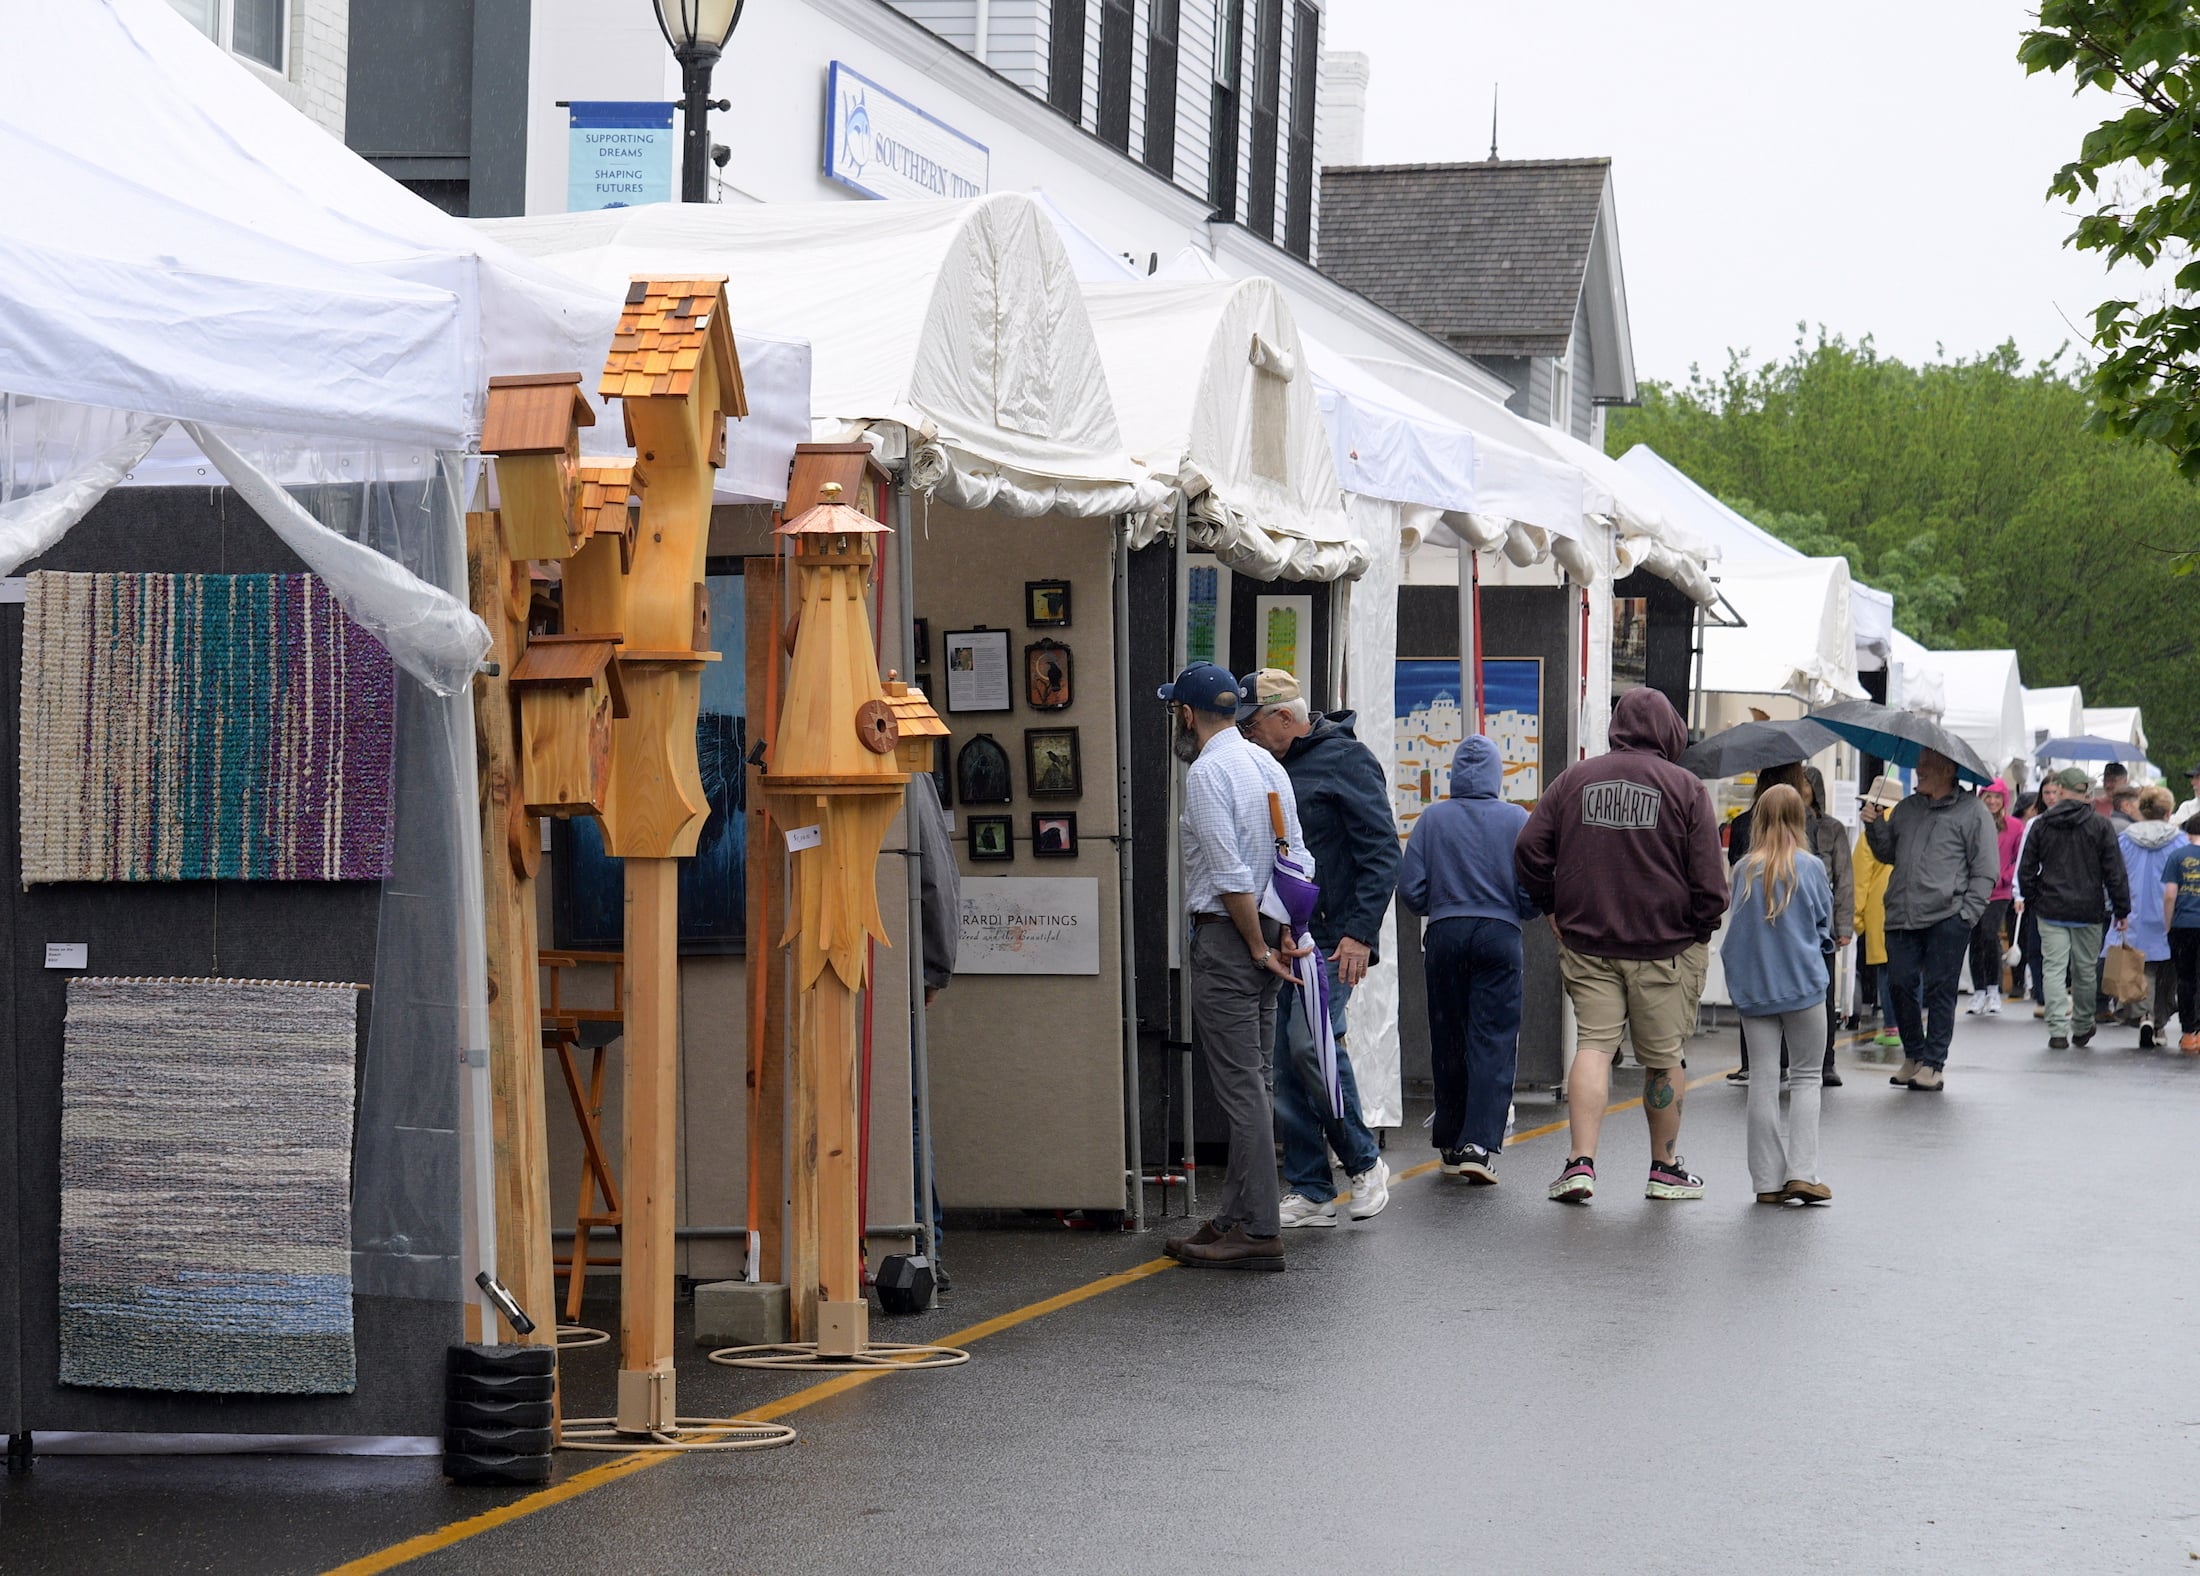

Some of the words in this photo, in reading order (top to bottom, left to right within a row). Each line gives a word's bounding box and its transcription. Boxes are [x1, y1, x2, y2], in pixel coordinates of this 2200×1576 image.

[585, 134, 654, 144] SUPPORTING
[599, 148, 643, 157] DREAMS
[875, 131, 948, 197] SOUTHERN
[594, 169, 643, 179] SHAPING
[596, 183, 644, 193] FUTURES
[1586, 782, 1658, 827] CARHARTT
[961, 914, 1003, 926] RARDI
[1007, 914, 1078, 926] PAINTINGS
